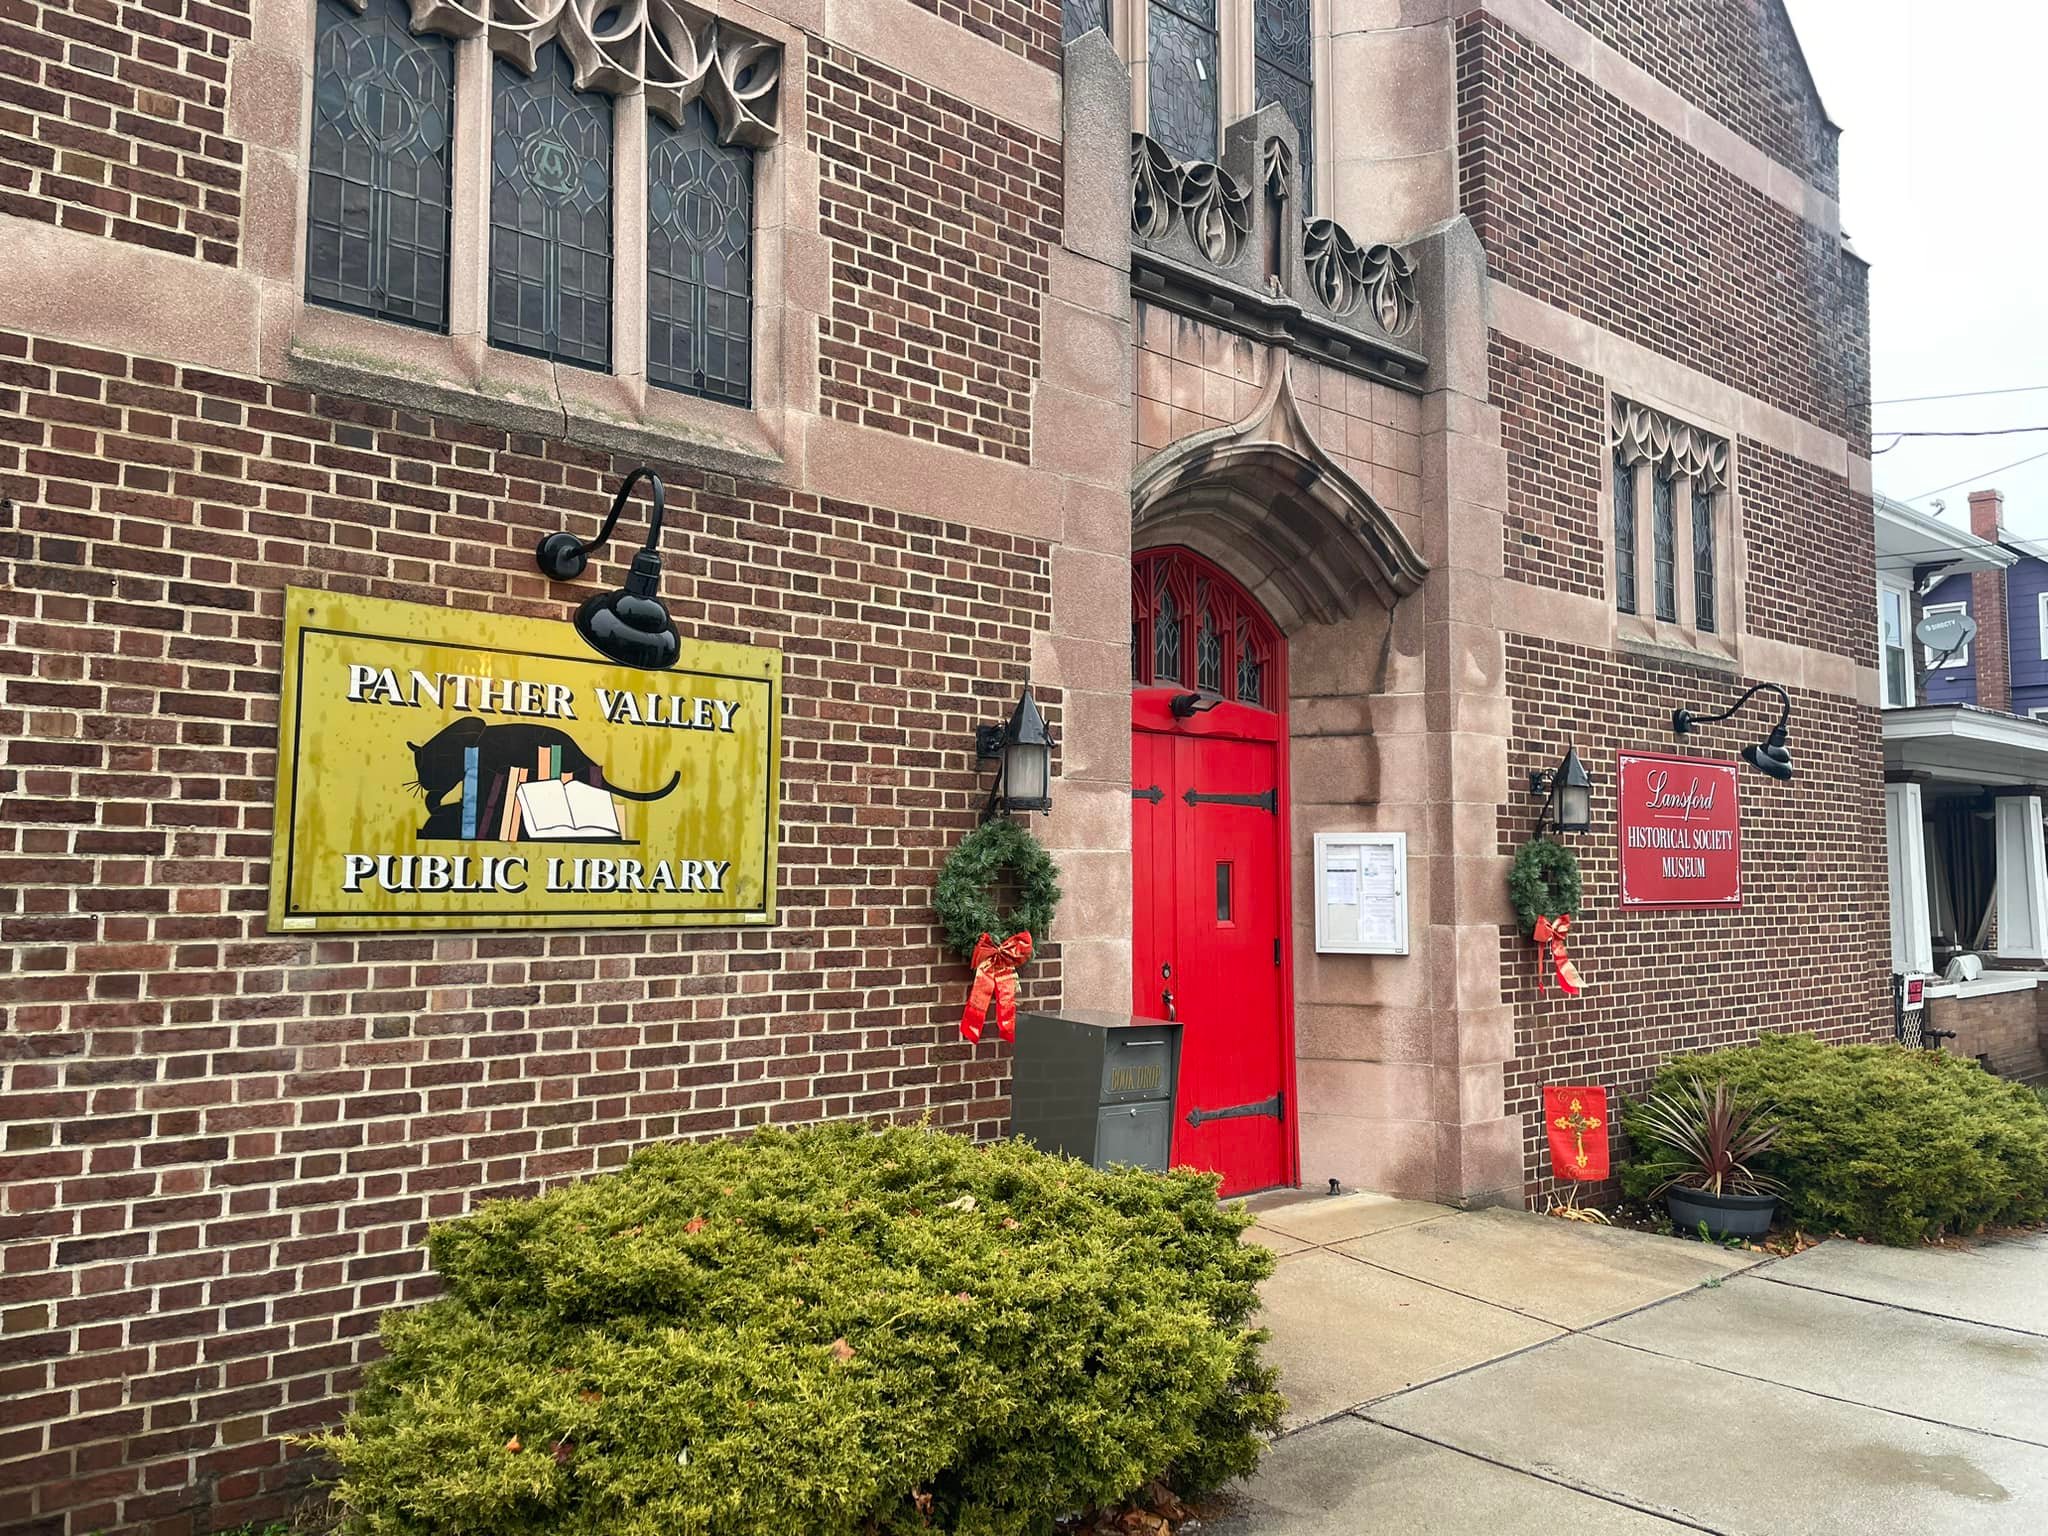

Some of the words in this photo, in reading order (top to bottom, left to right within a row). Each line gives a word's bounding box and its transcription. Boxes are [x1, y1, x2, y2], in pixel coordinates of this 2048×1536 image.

[347, 664, 577, 720] PANTHER
[594, 687, 741, 733] VALLEY
[1646, 769, 1716, 821] Lansford
[1628, 826, 1691, 849] HISTORICAL
[1693, 829, 1733, 850] SOCIETY
[341, 854, 529, 894] PUBLIC
[545, 857, 730, 894] LIBRARY
[1662, 857, 1706, 878] MUSEUM
[1111, 1066, 1136, 1090] BOOK
[1137, 1064, 1161, 1088] DROP
